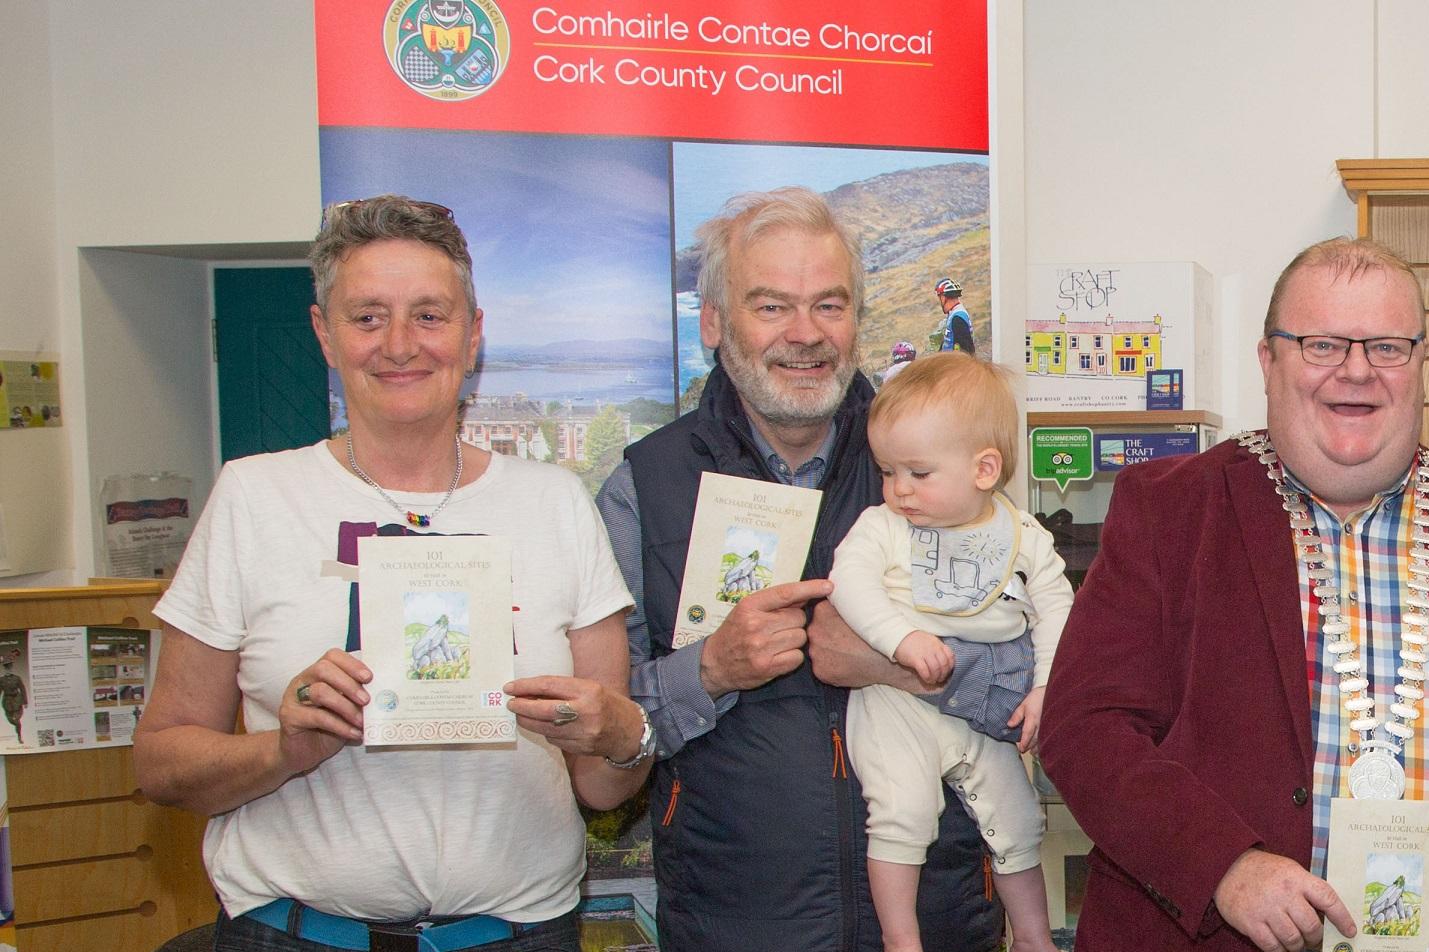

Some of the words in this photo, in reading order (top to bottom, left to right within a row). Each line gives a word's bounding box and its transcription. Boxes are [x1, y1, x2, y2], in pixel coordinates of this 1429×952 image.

[532, 7, 689, 41] Comhairle
[697, 15, 811, 48] Contae
[818, 22, 933, 55] Chorcaí
[532, 54, 605, 85] Cork
[614, 58, 726, 96] County
[734, 65, 843, 96] Council
[1060, 269, 1121, 296] CRAFT
[1056, 287, 1118, 311] SHOP
[1125, 439, 1143, 448] THE
[1125, 448, 1154, 456] CRAFT
[753, 493, 767, 503] 101
[713, 496, 785, 515] ARCHAEOLOGICAL
[734, 515, 753, 525] WEST
[755, 519, 777, 530] CORK
[427, 551, 444, 561] 101
[379, 560, 464, 570] ARCHAEOLOGICAL
[465, 561, 491, 570] SITES
[408, 579, 432, 588] WEST
[435, 579, 463, 589] CORK
[488, 699, 502, 707] RK
[1391, 815, 1406, 825] 101
[1347, 823, 1425, 835] ARCHAEOLOGICAL
[1373, 841, 1393, 850] WEST
[1396, 842, 1420, 851] CORK
